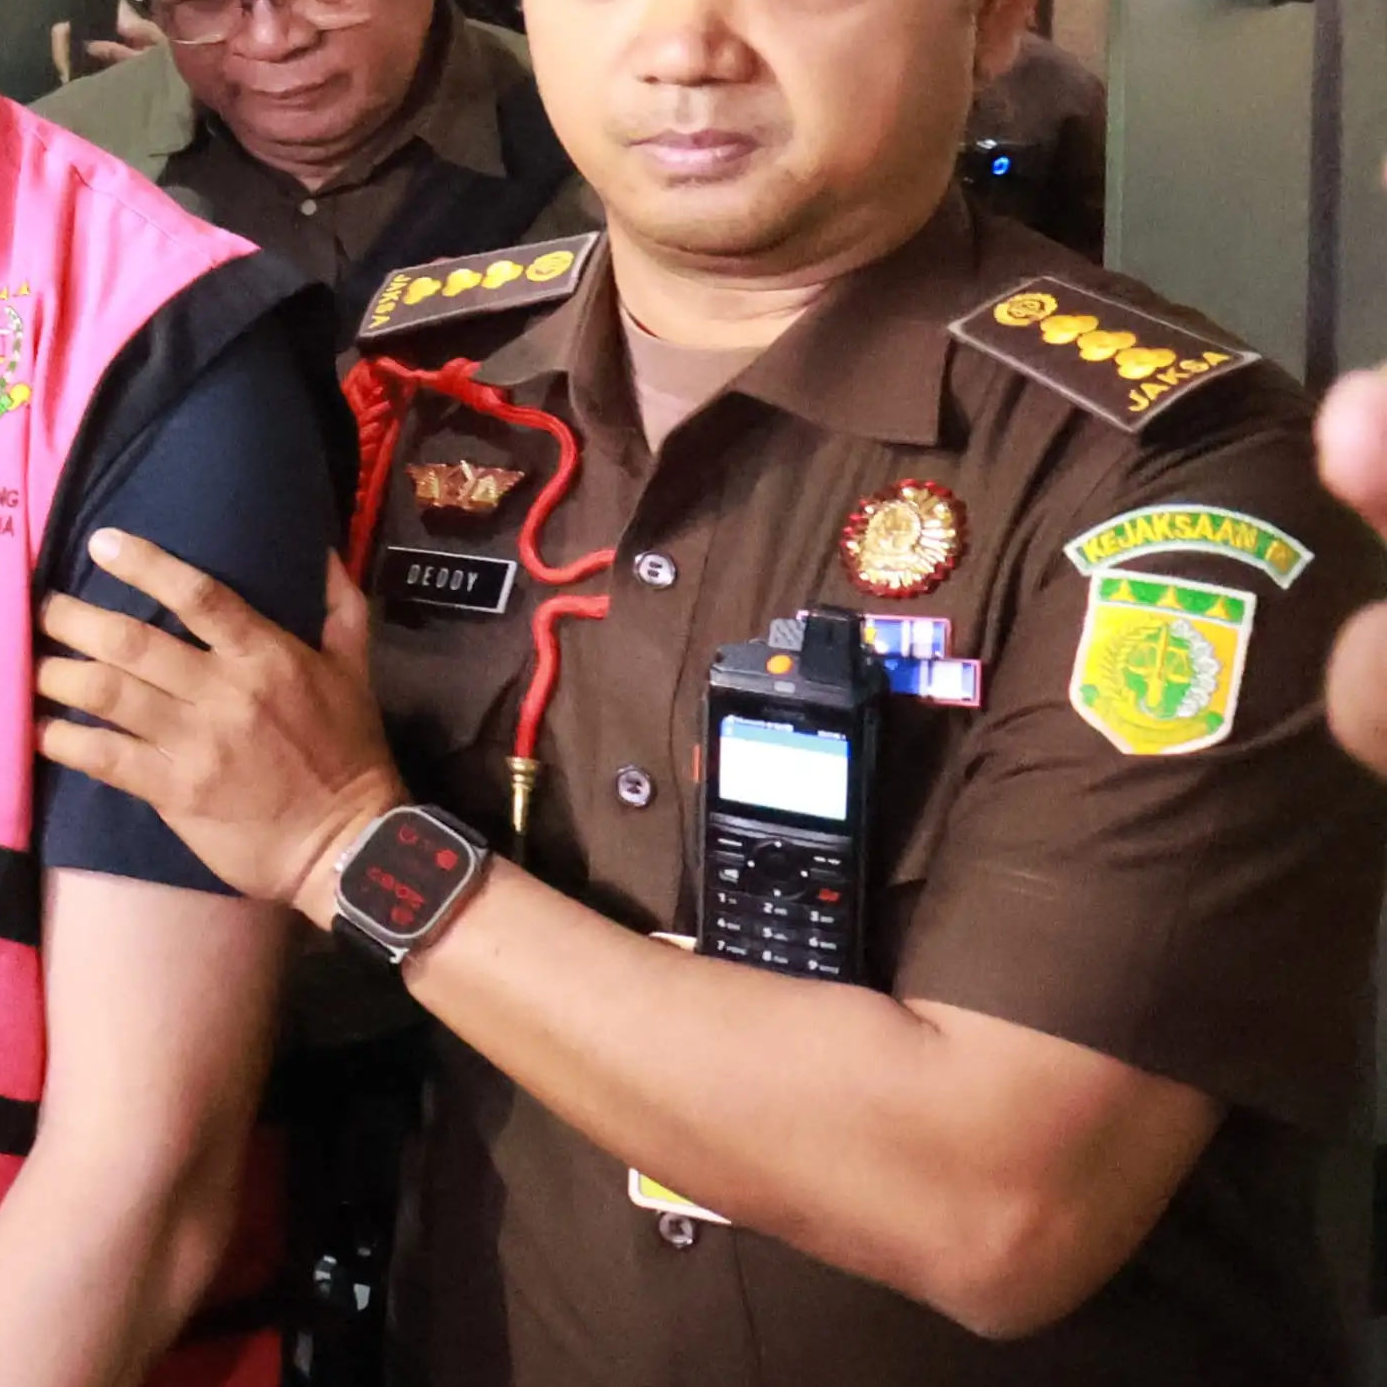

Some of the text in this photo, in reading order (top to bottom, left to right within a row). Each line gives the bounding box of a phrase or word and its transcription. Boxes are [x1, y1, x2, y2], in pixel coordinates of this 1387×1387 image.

[368, 273, 412, 330] JAKSA
[1129, 351, 1231, 412] JAKSA
[1081, 511, 1259, 565] KEJAKSAAN
